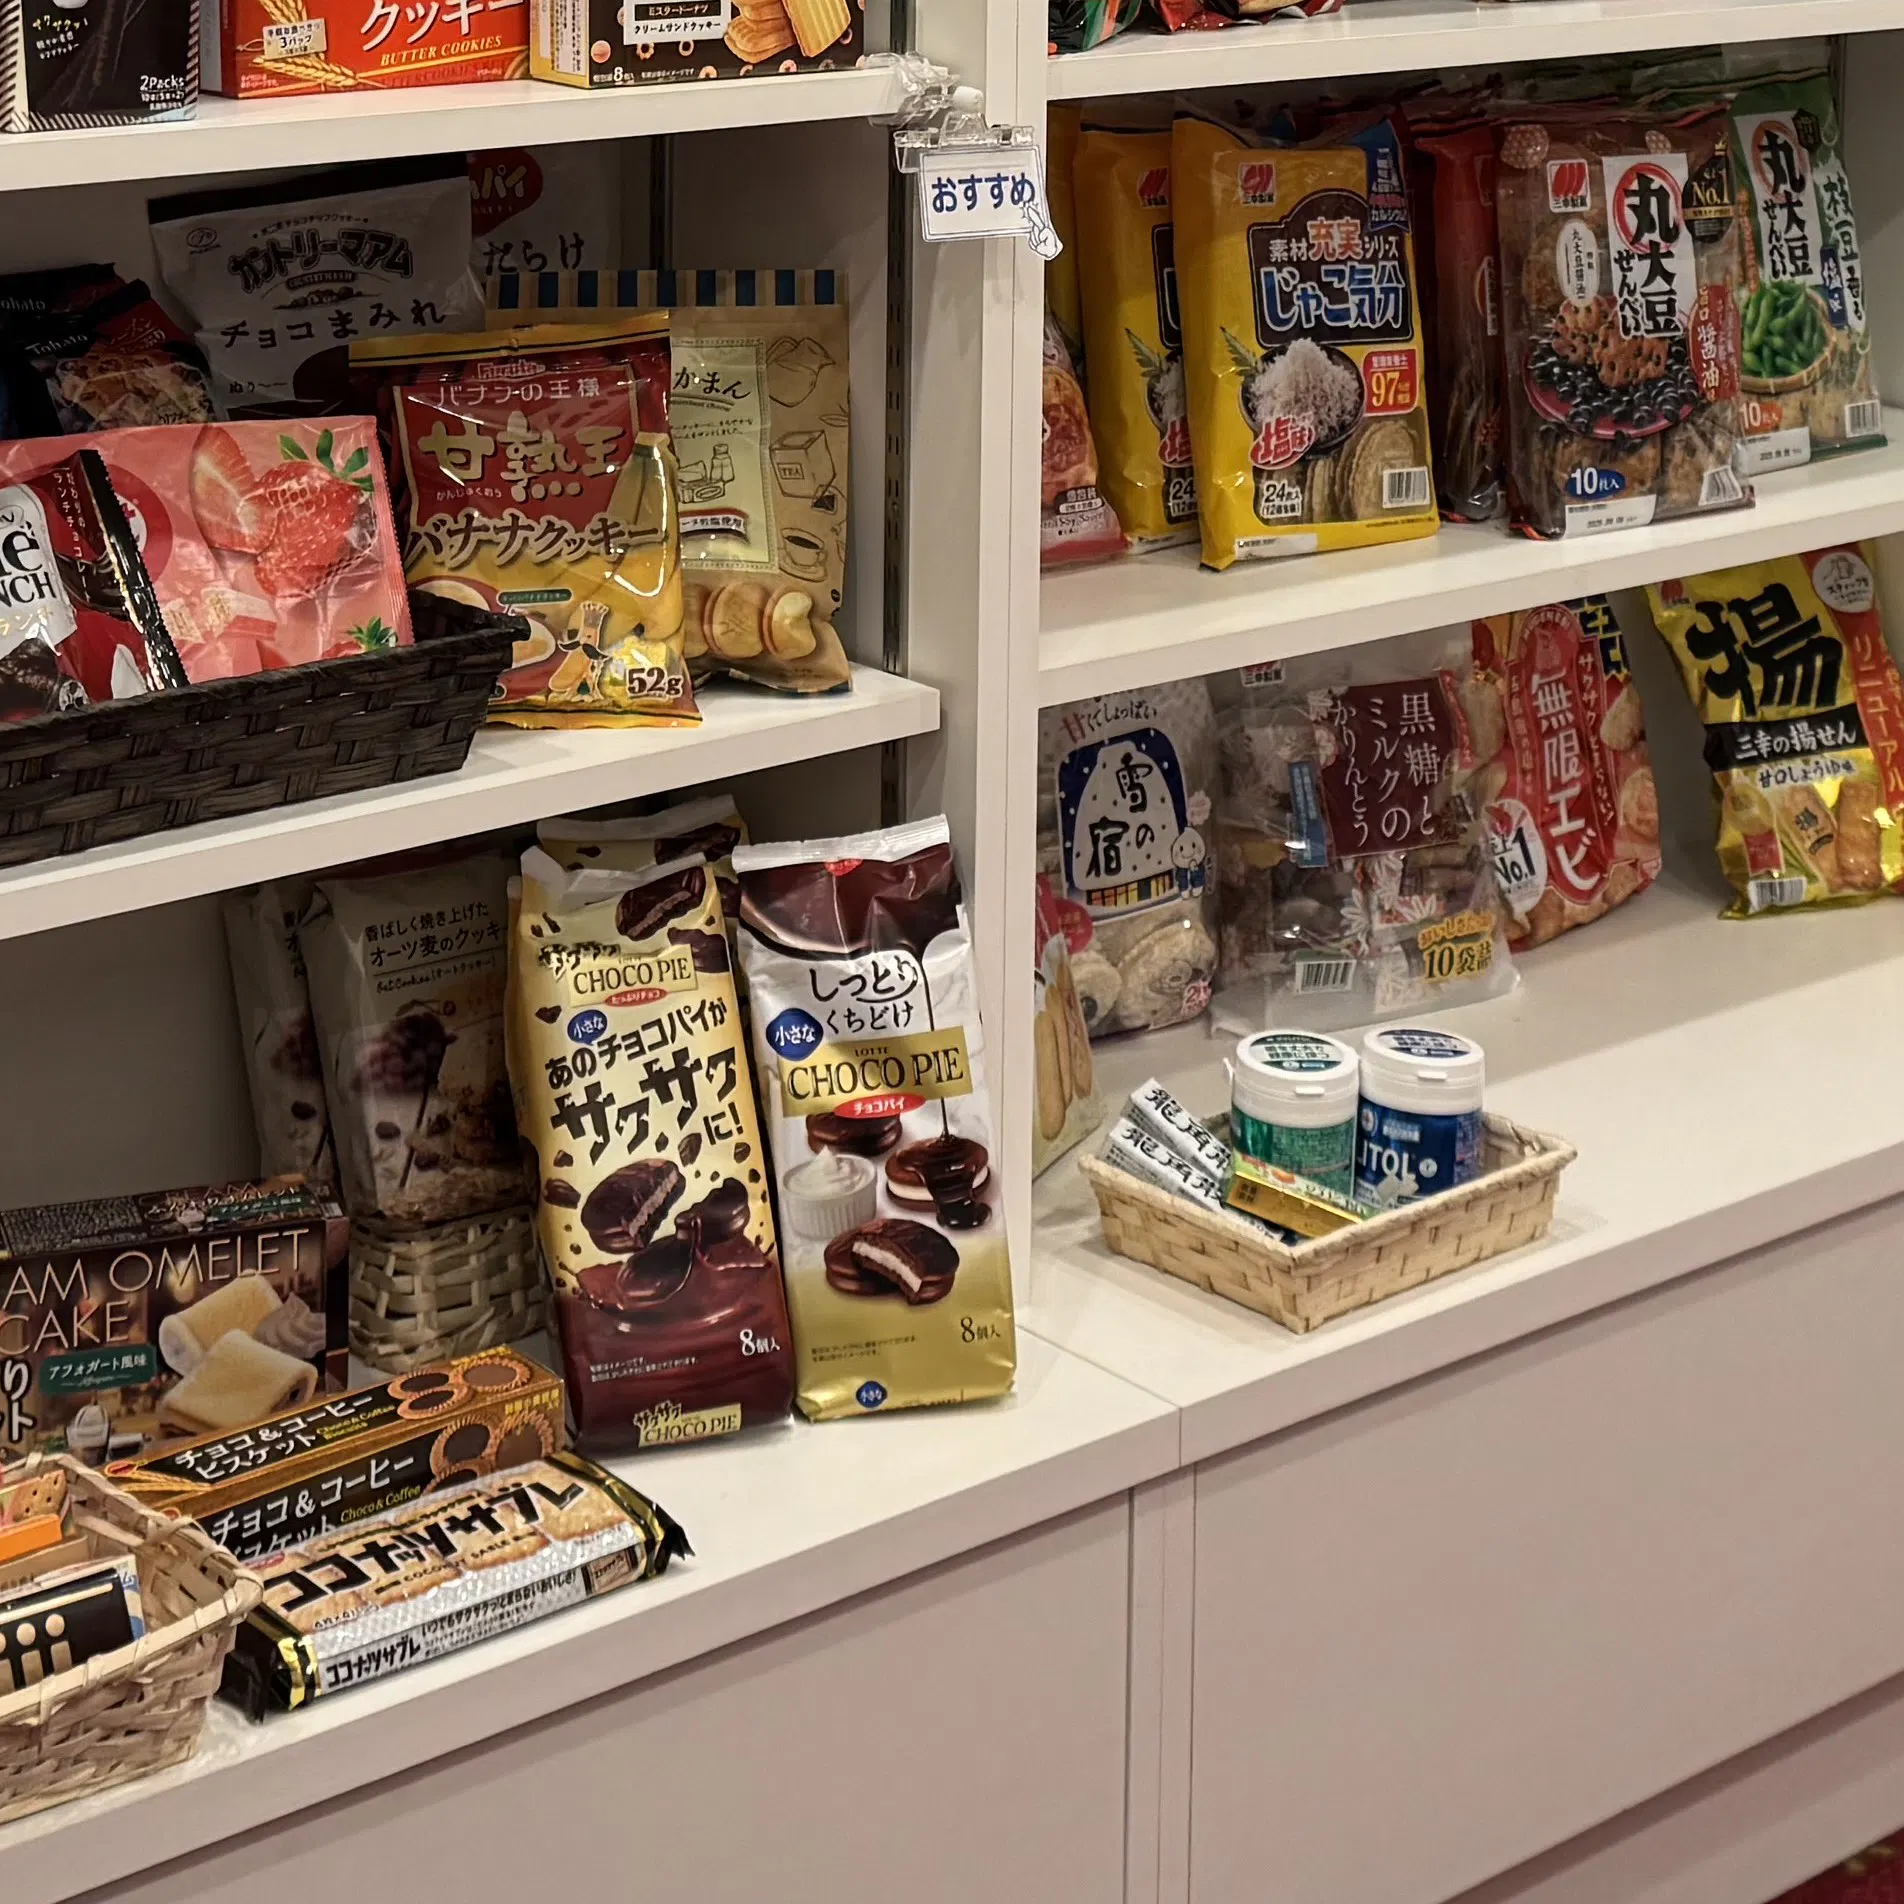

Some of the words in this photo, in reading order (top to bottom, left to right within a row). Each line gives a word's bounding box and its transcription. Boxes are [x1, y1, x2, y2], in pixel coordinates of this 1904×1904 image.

[380, 45, 435, 68] BUTTER
[439, 35, 502, 58] COOKIES
[931, 176, 1035, 215] おすすめ
[1758, 131, 1812, 279] 丸大豆
[1623, 174, 1680, 336] 丸大豆
[1260, 261, 1405, 331] じゃこ気分
[1614, 249, 1642, 338] せんべい
[1371, 372, 1399, 406] 97
[417, 409, 626, 501] 甘熟王
[408, 514, 662, 563] バナナクッキー
[1685, 583, 1844, 719] 揚
[626, 665, 683, 698] 52g
[1399, 693, 1441, 837] 黒糖と
[1734, 721, 1858, 762] 三幸の揚せん
[1332, 701, 1370, 848] かりんとう
[1367, 698, 1412, 839] ミルクの
[1532, 674, 1599, 889] 無限エビ
[1088, 753, 1156, 879] 雪の宿
[573, 963, 650, 995] CHOCO
[654, 956, 692, 987] PIE
[808, 952, 920, 1001] しっとり
[571, 1018, 608, 1038] 小さな
[774, 1024, 815, 1046] 小さな
[825, 1004, 915, 1033] くちどけ
[545, 997, 728, 1091] あのチョコパイが
[854, 1046, 891, 1059] LOTTE
[787, 1056, 906, 1101] CHOCO
[912, 1047, 964, 1087] PIE
[851, 1097, 908, 1116] チョコパイ
[108, 1229, 309, 1294] OMELET
[960, 1316, 1002, 1344] 8個入
[47, 1354, 148, 1380] アフォガート風味
